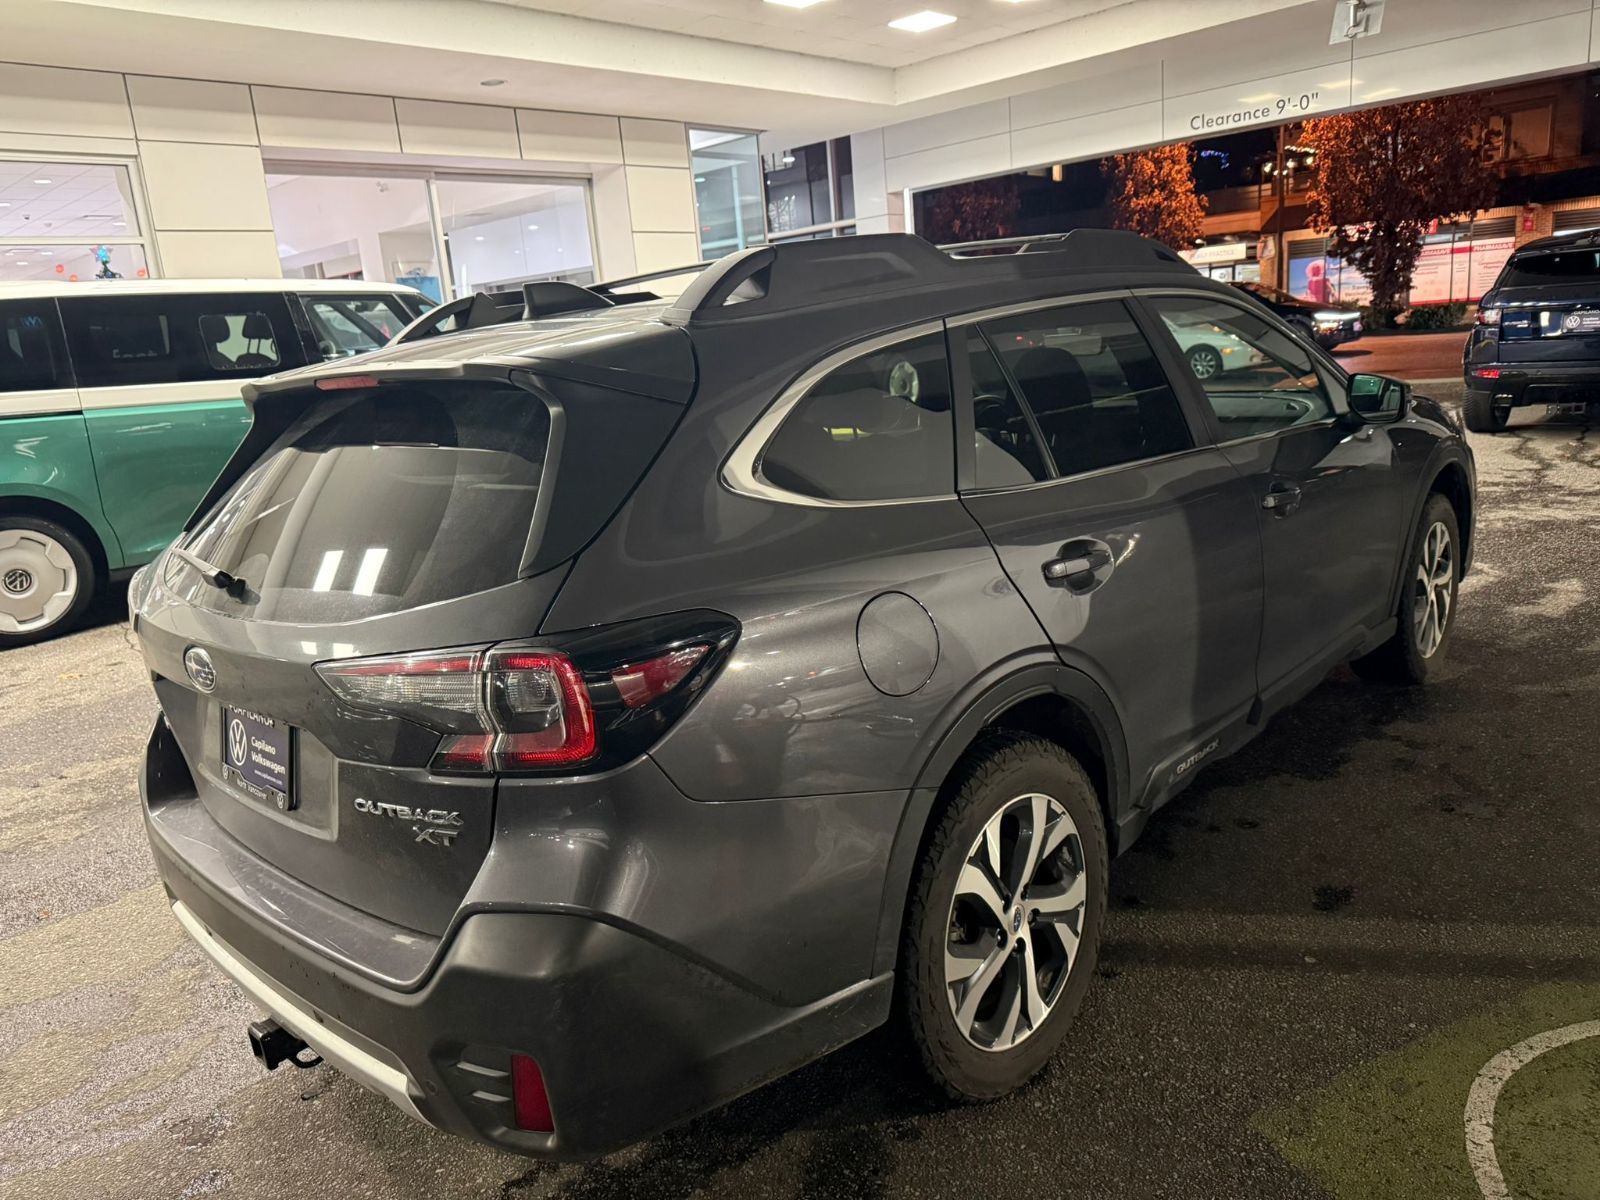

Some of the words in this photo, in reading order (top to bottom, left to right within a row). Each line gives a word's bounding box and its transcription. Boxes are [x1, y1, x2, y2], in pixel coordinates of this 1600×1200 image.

[1190, 107, 1270, 130] Clearance
[1276, 92, 1319, 115] 9'-0"
[251, 736, 276, 755] Capilano
[251, 751, 286, 775] Volkswagen
[354, 798, 464, 826] OUTBACK
[412, 825, 460, 846] XT
